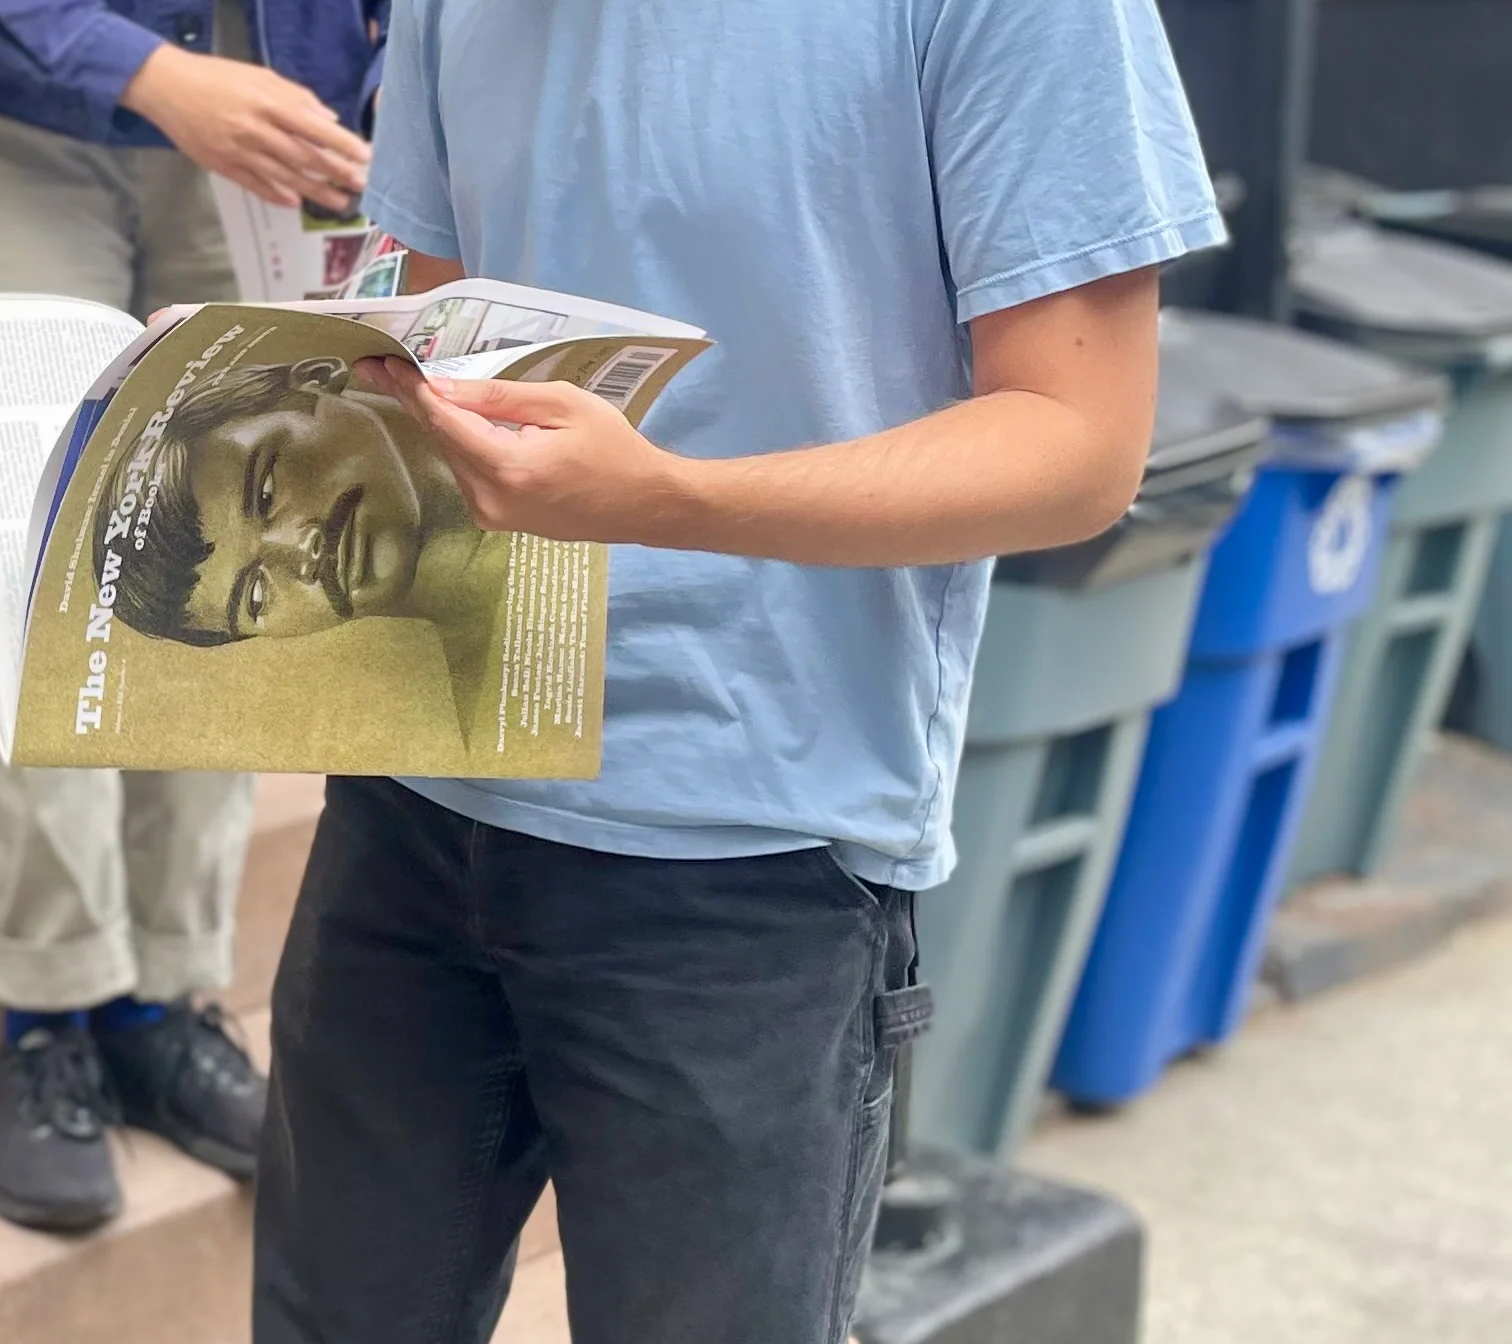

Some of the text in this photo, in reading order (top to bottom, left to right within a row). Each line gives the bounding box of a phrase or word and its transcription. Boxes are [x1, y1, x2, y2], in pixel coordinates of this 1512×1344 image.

[139, 324, 245, 441] Review
[59, 407, 138, 613] David Shulman: Israel in Denial
[104, 440, 154, 545] York
[134, 463, 166, 551] of Books
[516, 577, 525, 612] Prints
[519, 565, 526, 576] in
[540, 550, 549, 594] Sargent
[561, 550, 569, 602] Graham's
[85, 548, 123, 642] New
[526, 569, 536, 630] Eisenman's
[538, 595, 547, 632] Singer
[536, 633, 544, 660] John
[544, 674, 553, 710] Ingrid
[549, 547, 560, 623] Contradictory
[559, 603, 567, 644] Martha
[497, 717, 507, 752] Darryl
[502, 587, 515, 662] Rediscovering
[524, 631, 533, 666] Nicole
[75, 650, 107, 734] The
[511, 664, 520, 696] Susan
[574, 699, 583, 738] Jarrett
[581, 613, 587, 625] of
[520, 694, 528, 728] Julian
[531, 703, 540, 736] James
[554, 684, 563, 724] Marina
